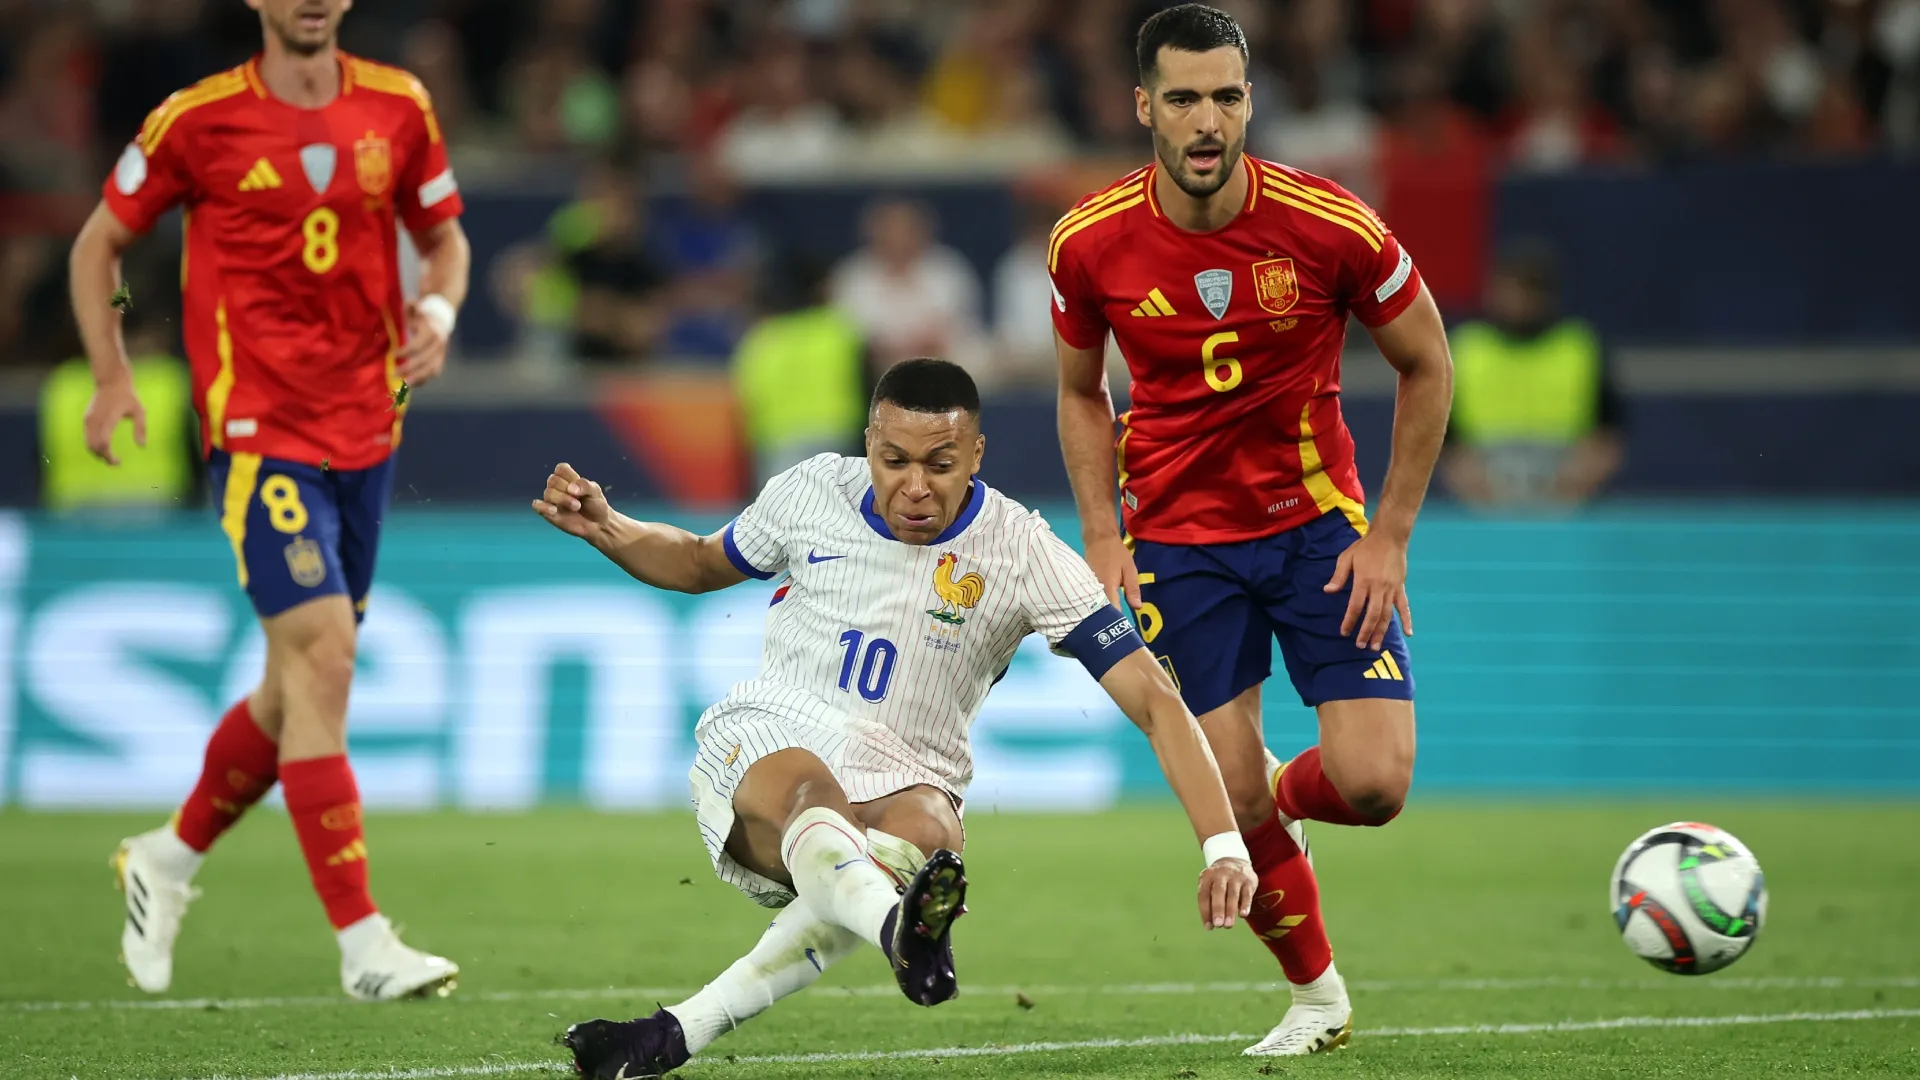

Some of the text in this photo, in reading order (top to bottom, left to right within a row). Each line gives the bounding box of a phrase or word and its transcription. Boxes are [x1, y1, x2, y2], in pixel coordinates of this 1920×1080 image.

[302, 206, 340, 275] 8
[1201, 331, 1243, 392] 6
[260, 473, 309, 534] 8
[838, 628, 898, 704] 10
